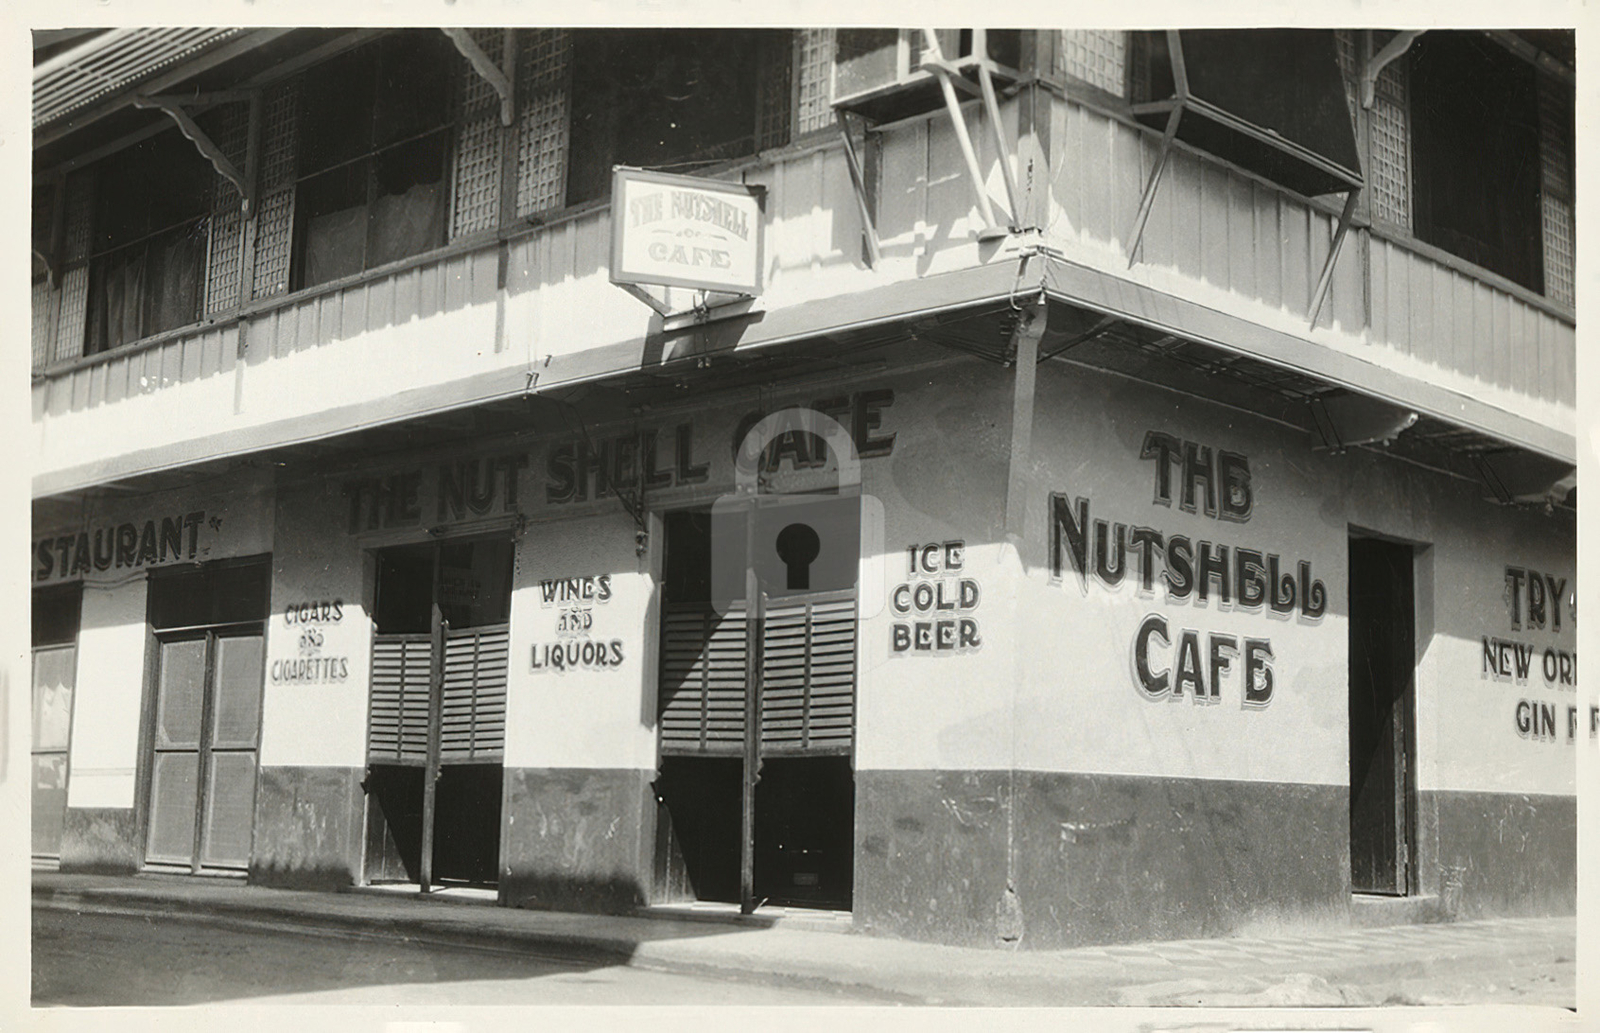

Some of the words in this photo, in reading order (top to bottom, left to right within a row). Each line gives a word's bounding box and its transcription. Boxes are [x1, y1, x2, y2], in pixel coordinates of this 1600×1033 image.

[630, 192, 664, 229] THE
[670, 190, 750, 242] NUTSHELL
[648, 241, 732, 270] CAFE
[342, 469, 423, 535] THE
[437, 453, 529, 522] NUT
[546, 422, 711, 505] SHELL
[731, 389, 898, 473] CAFE
[1139, 430, 1254, 524] THE
[32, 511, 205, 581] STAURANT
[906, 540, 965, 578] ICE
[1048, 491, 1327, 625] NUTSHELL
[538, 574, 612, 608] WINES
[889, 578, 982, 618] COLD
[1504, 566, 1567, 632] TRY
[284, 599, 344, 628] CIGARS
[556, 612, 593, 634] AND
[530, 640, 624, 674] LIQUORS
[889, 617, 982, 657] BEER
[272, 657, 348, 684] CIGARETTES
[1130, 612, 1276, 711] CAFE
[1483, 635, 1534, 685] NEW
[1517, 699, 1556, 742] GIN
